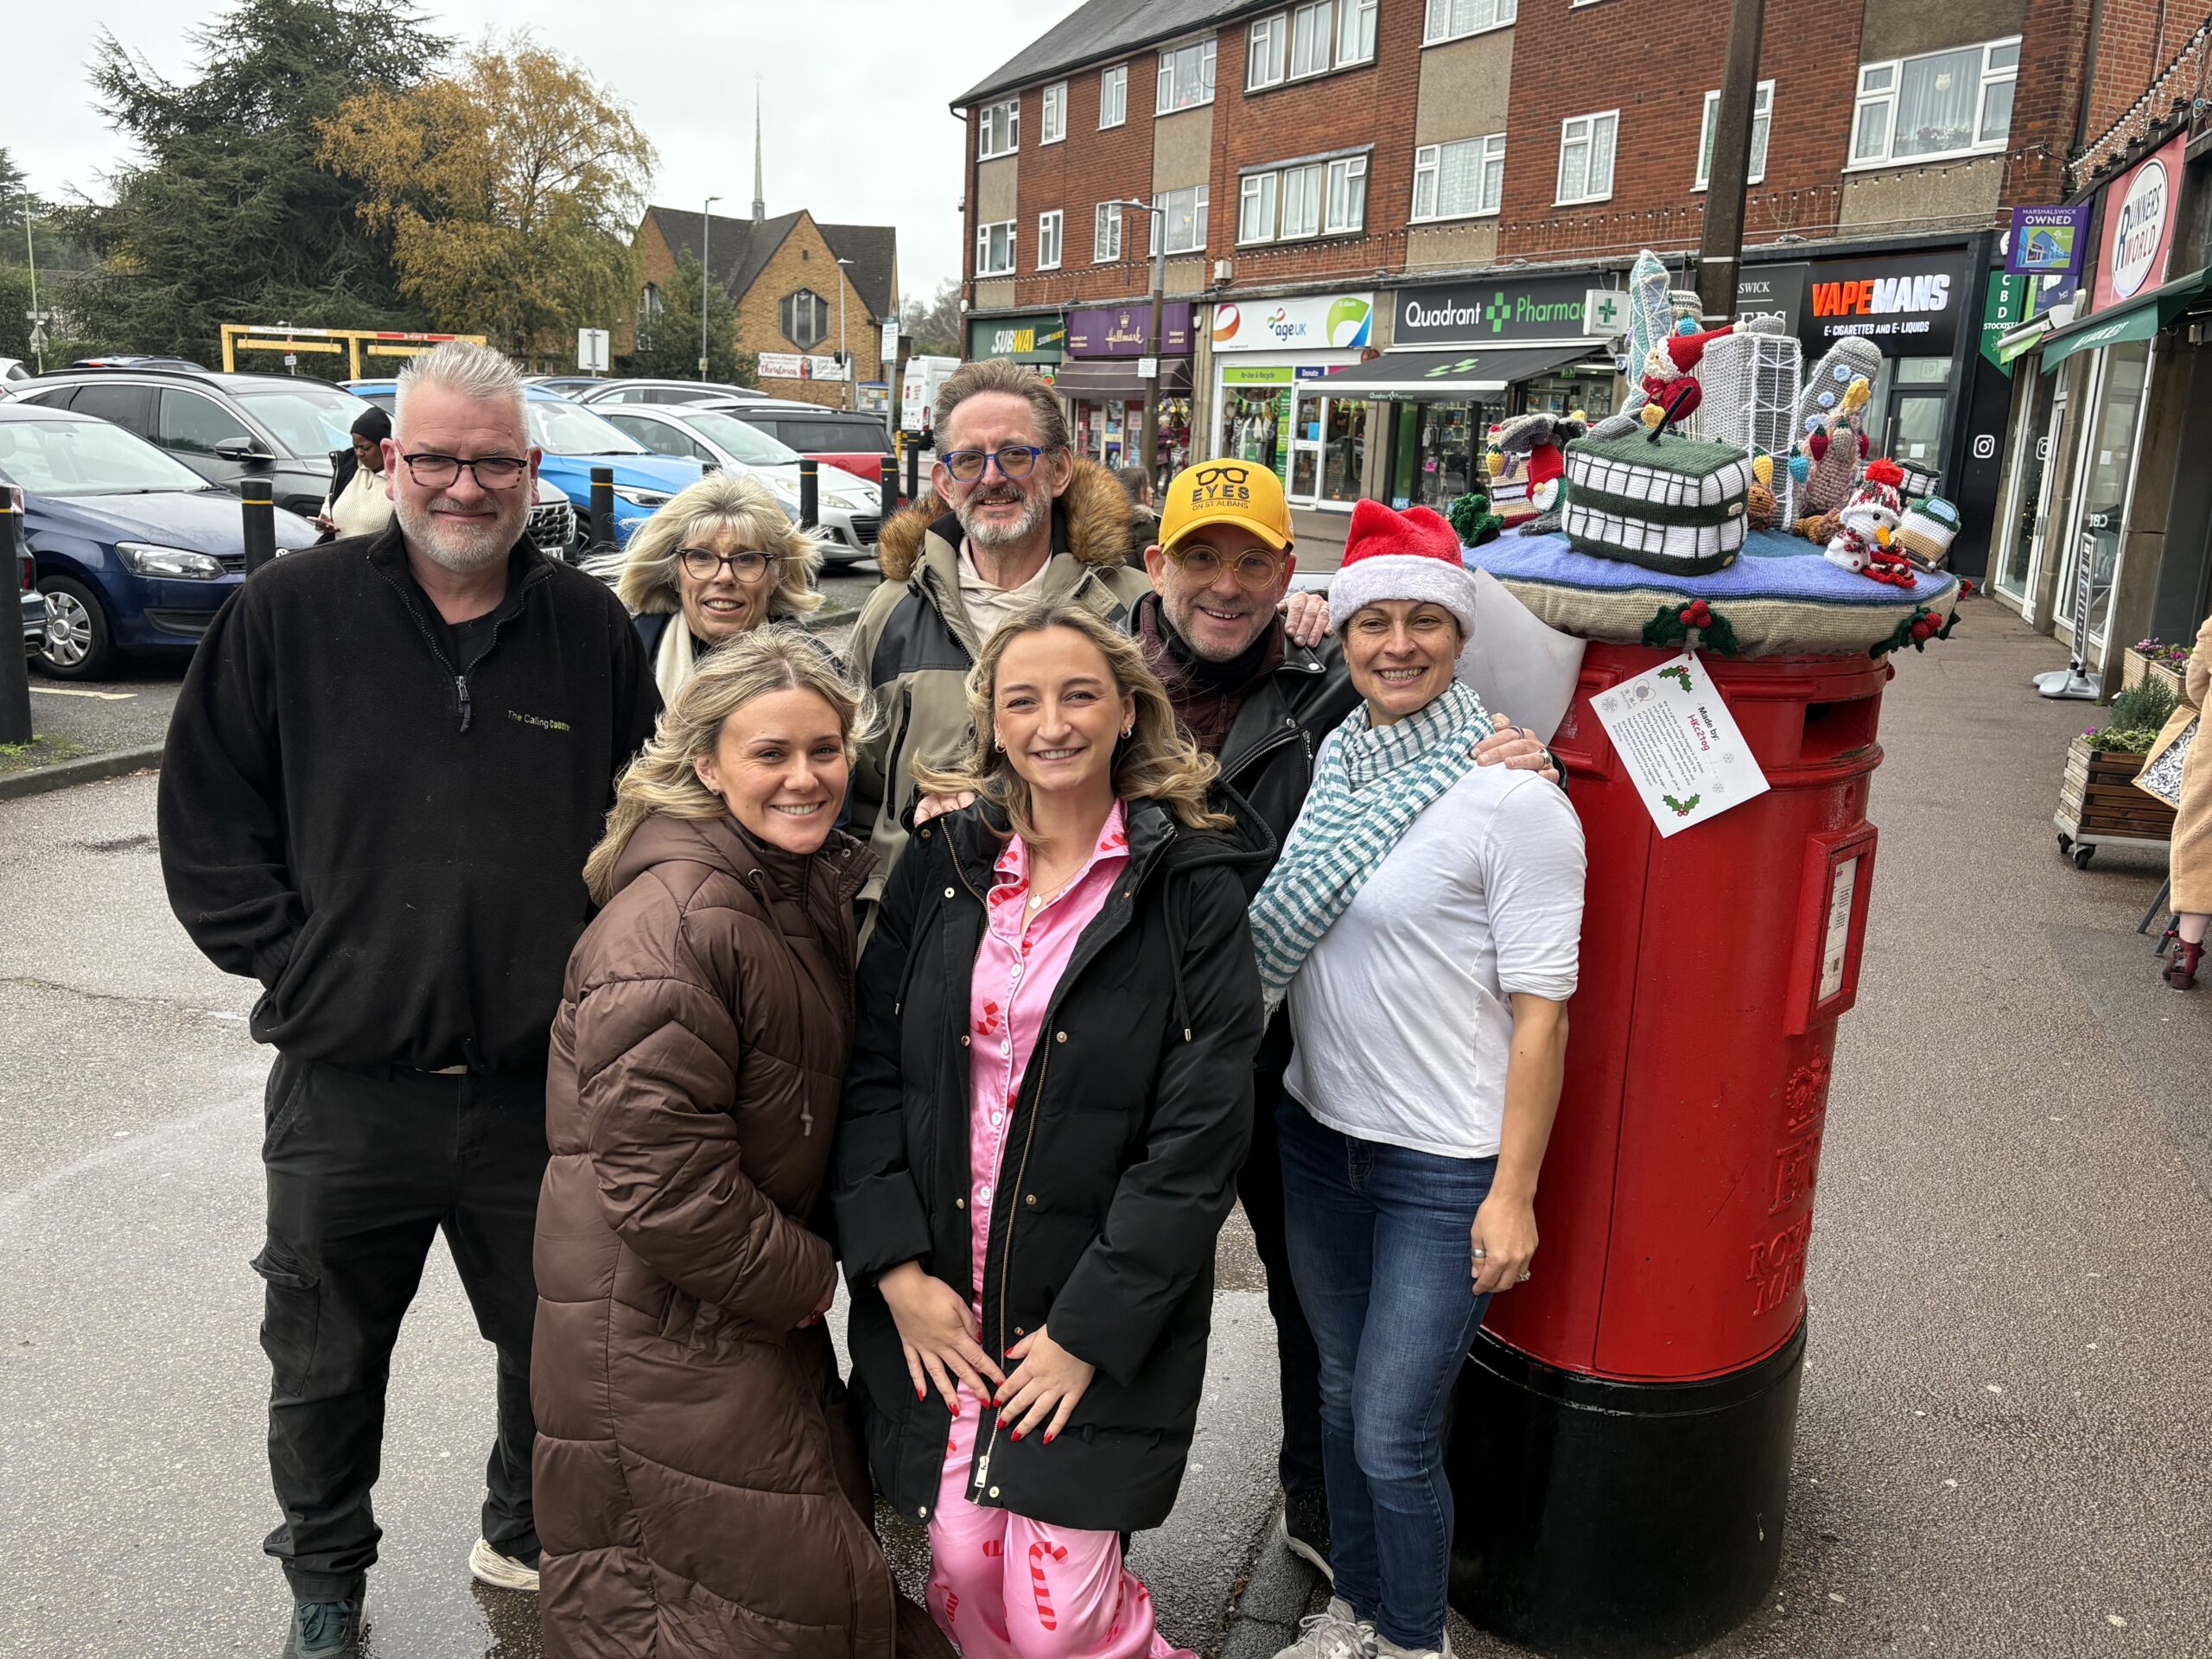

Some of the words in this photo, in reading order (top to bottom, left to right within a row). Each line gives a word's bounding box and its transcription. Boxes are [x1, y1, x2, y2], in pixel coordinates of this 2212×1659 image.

[2024, 215, 2072, 225] OWNED
[2115, 183, 2162, 271] RUNNERS
[2125, 225, 2156, 267] WORLD
[1812, 274, 1950, 317] VAPEMANS
[1405, 299, 1481, 327] Quadrant
[1105, 326, 1144, 351] Hallmark
[1833, 323, 1874, 335] CIGARETTES
[1876, 324, 1891, 334] AND
[1901, 321, 1929, 334] LIQUIDS
[1192, 484, 1249, 502] EYES
[1217, 500, 1249, 509] ALBANS
[1392, 498, 1409, 509] NHS
[507, 710, 523, 721] The
[1698, 706, 1713, 728] Made
[1708, 728, 1721, 742] by:
[1688, 715, 1710, 751] HKc2tog
